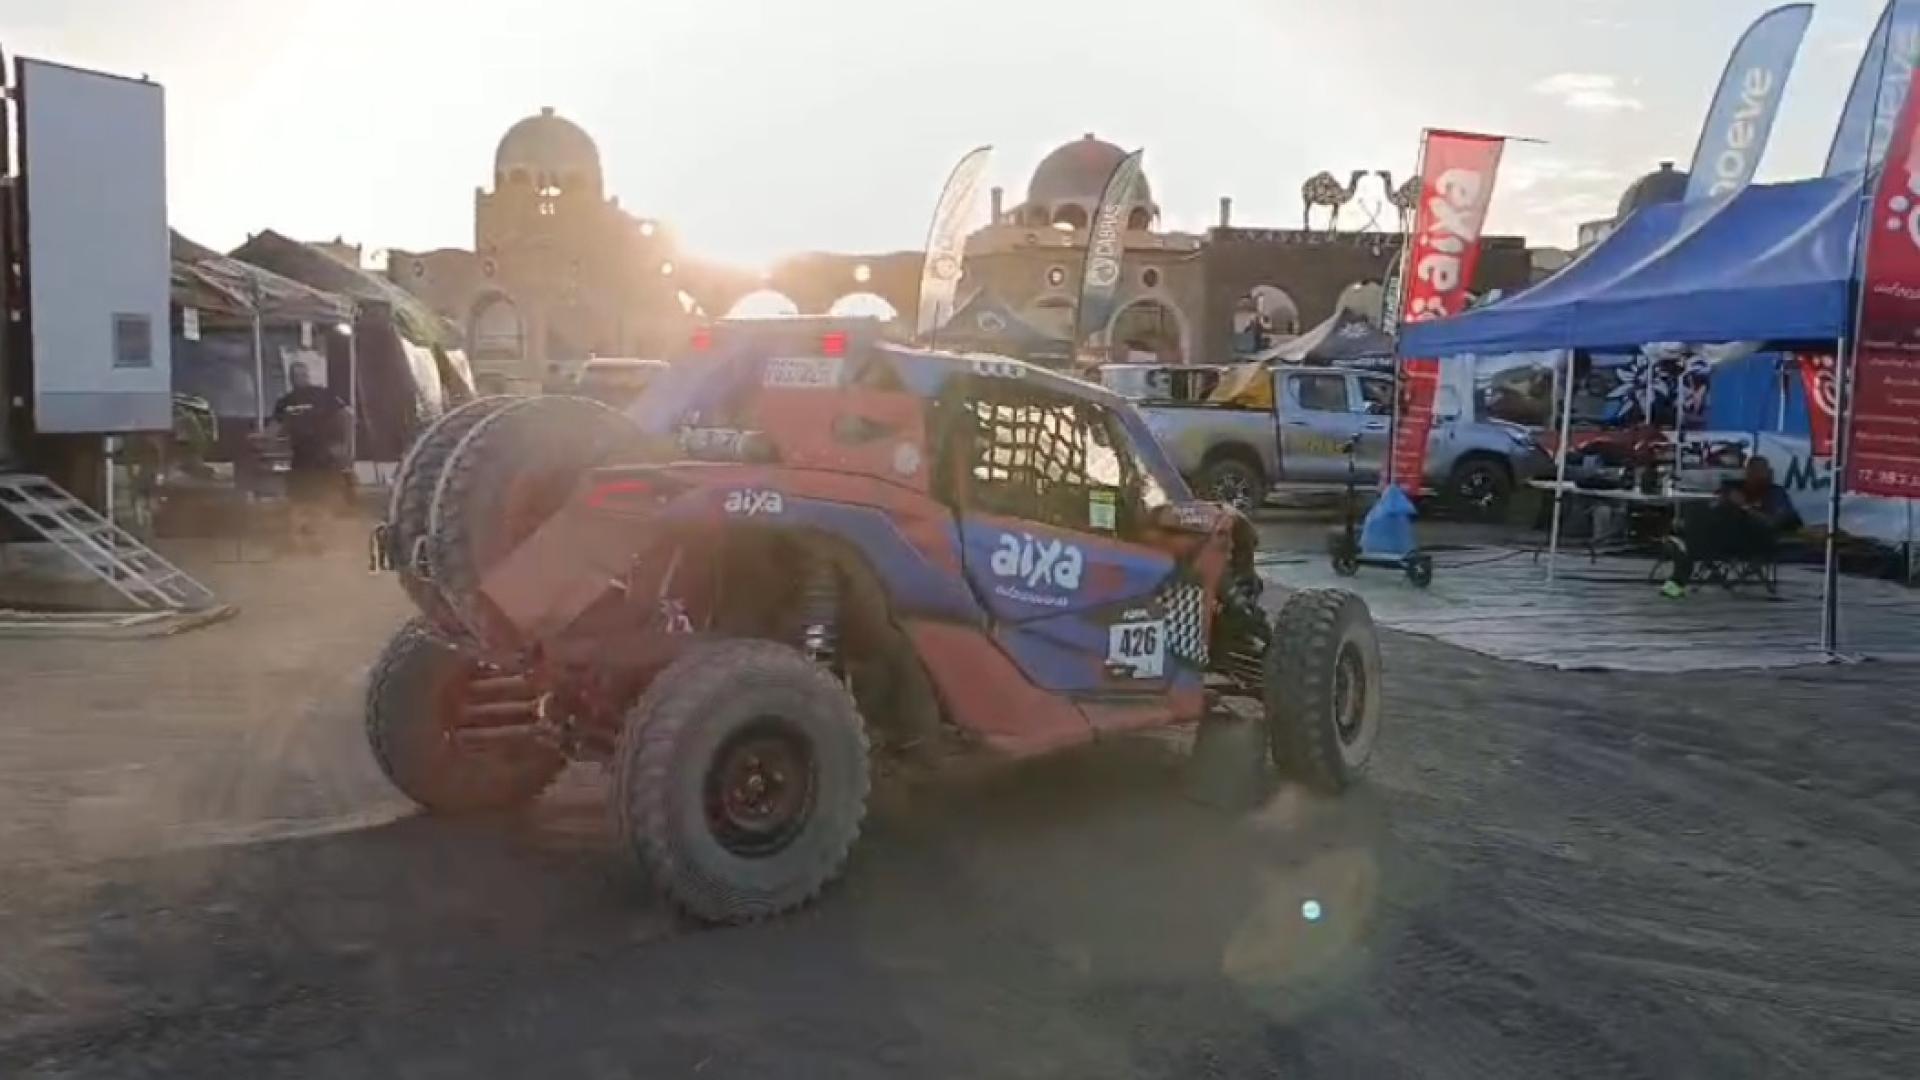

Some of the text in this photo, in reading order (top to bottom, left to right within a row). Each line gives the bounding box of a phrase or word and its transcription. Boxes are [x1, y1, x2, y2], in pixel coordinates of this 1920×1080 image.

[1417, 168, 1482, 291] aixa
[724, 488, 783, 515] aixa
[991, 533, 1083, 590] aixa
[1119, 626, 1157, 656] 426
